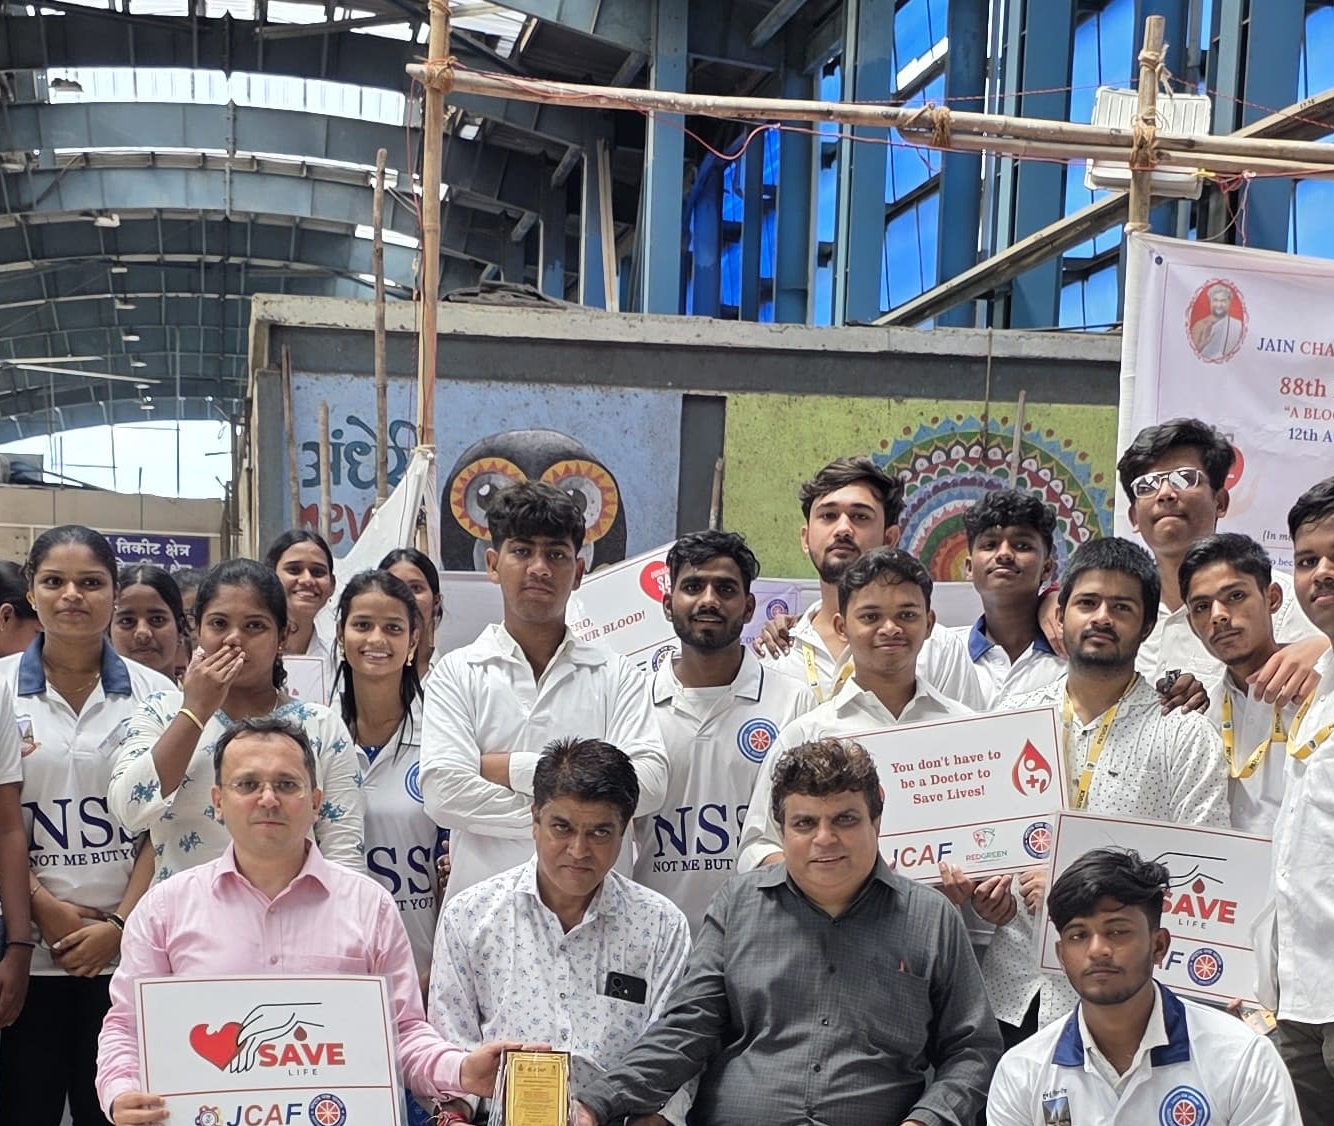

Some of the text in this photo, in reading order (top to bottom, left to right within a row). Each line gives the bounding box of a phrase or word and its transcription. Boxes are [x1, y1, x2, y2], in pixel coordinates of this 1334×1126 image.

[1256, 337, 1295, 353] JAIN
[1279, 376, 1327, 398] 88th
[1288, 427, 1317, 442] 12th
[115, 537, 192, 560] तिकीट क्षेत्र
[602, 610, 646, 636] BLOOD!
[890, 749, 1001, 774] You don't have to
[900, 767, 991, 790] be a Doctor to
[913, 785, 985, 805] Save Lives!
[21, 797, 139, 850] NS
[28, 854, 60, 868] NOT
[62, 853, 88, 866] ME
[91, 850, 119, 865] BUT
[652, 858, 734, 873] NOT ME BUT
[965, 850, 1008, 861] REDGREEN
[1178, 919, 1208, 929] LIFE
[258, 1043, 346, 1067] SAVE
[288, 1068, 318, 1076] LIFE
